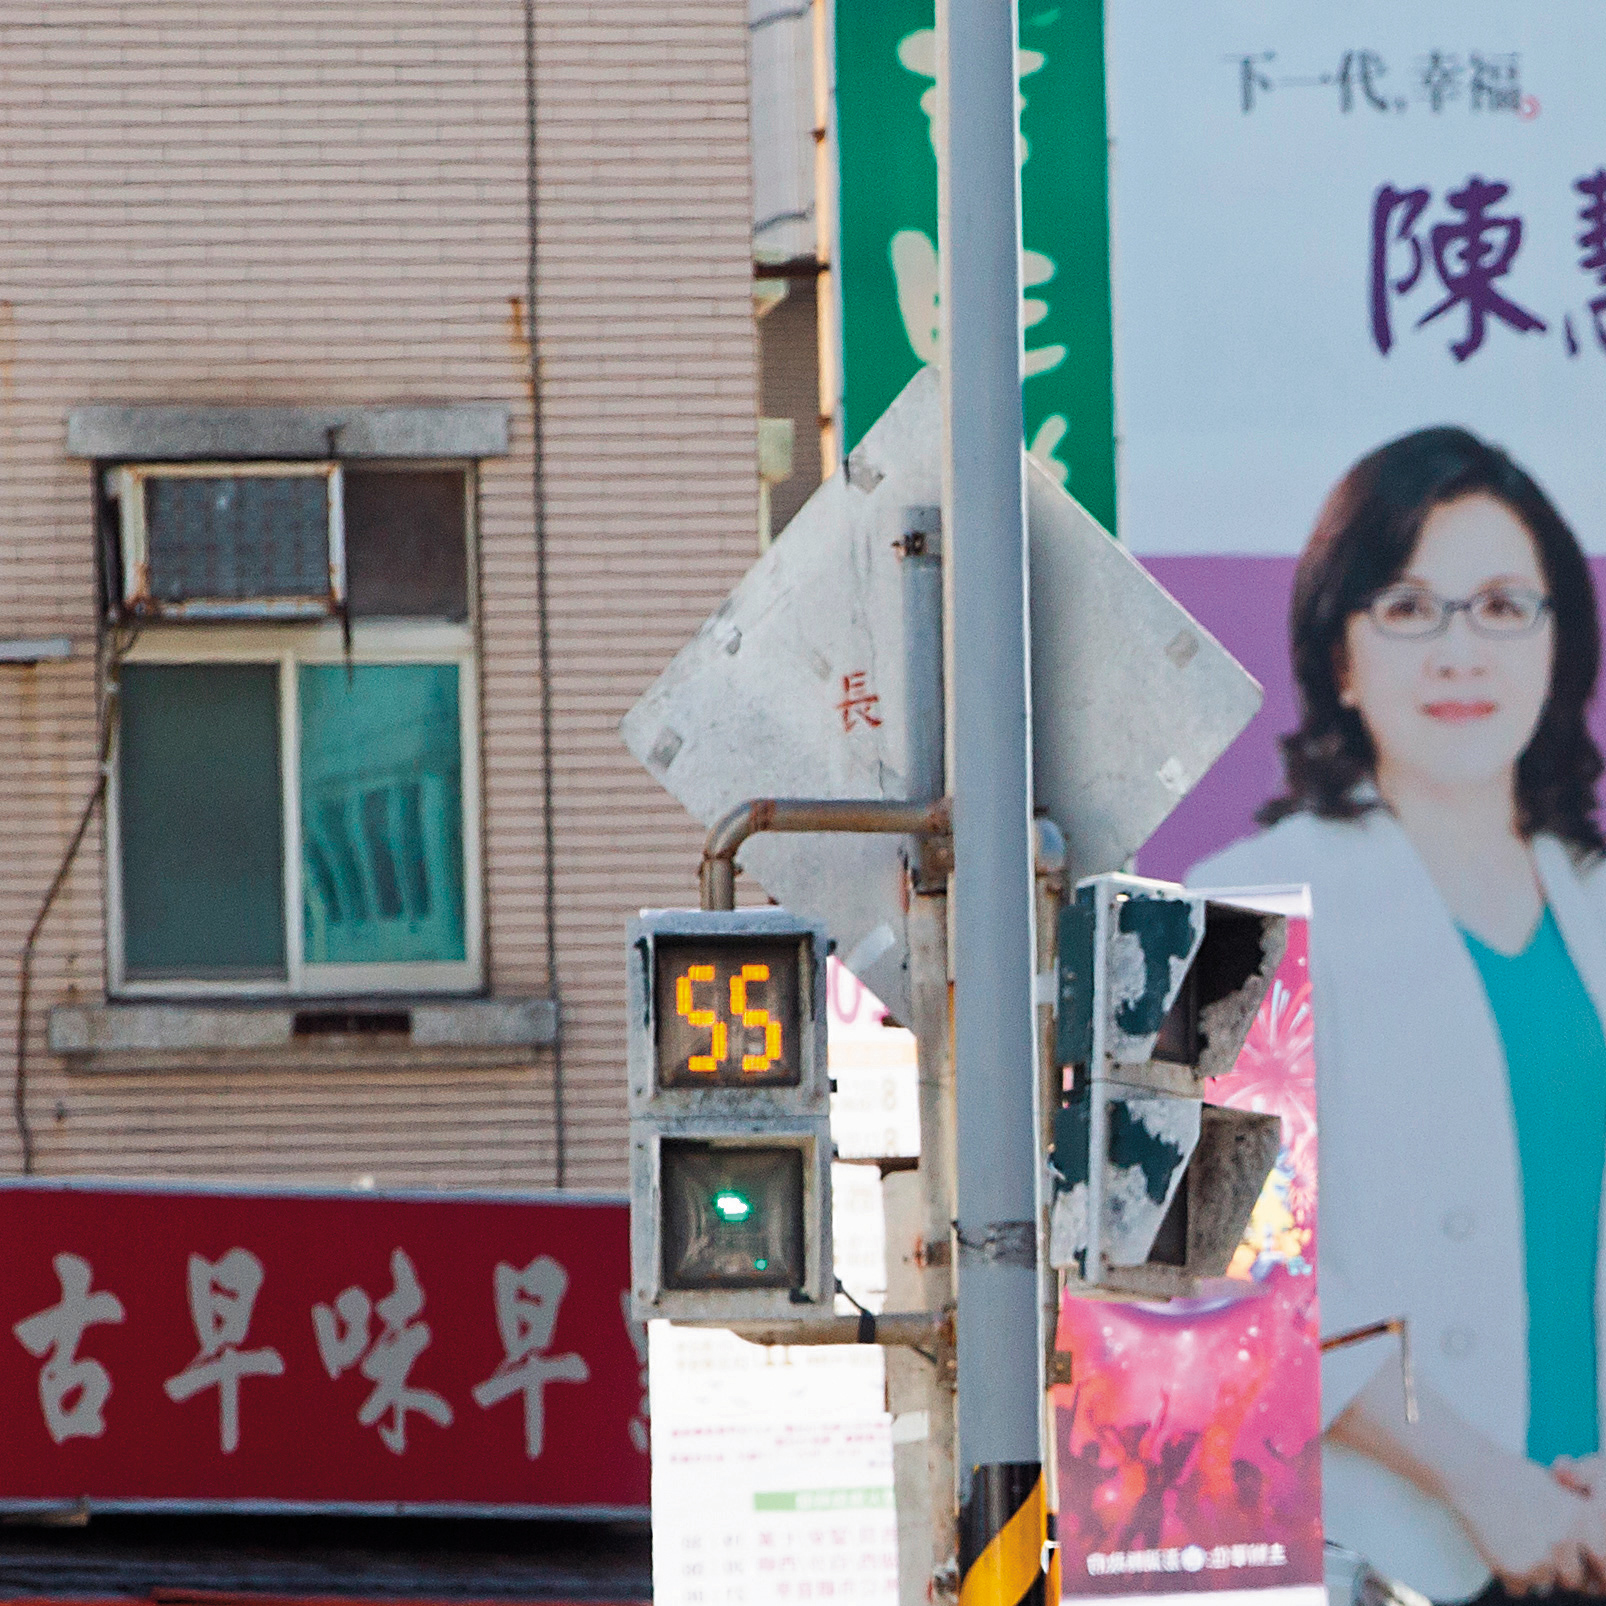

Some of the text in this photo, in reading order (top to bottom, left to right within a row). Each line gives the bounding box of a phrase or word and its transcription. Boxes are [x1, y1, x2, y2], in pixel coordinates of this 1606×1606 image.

[837, 671, 882, 733] 長
[676, 964, 782, 1073] 55
[13, 1246, 650, 1459] 古早味早
